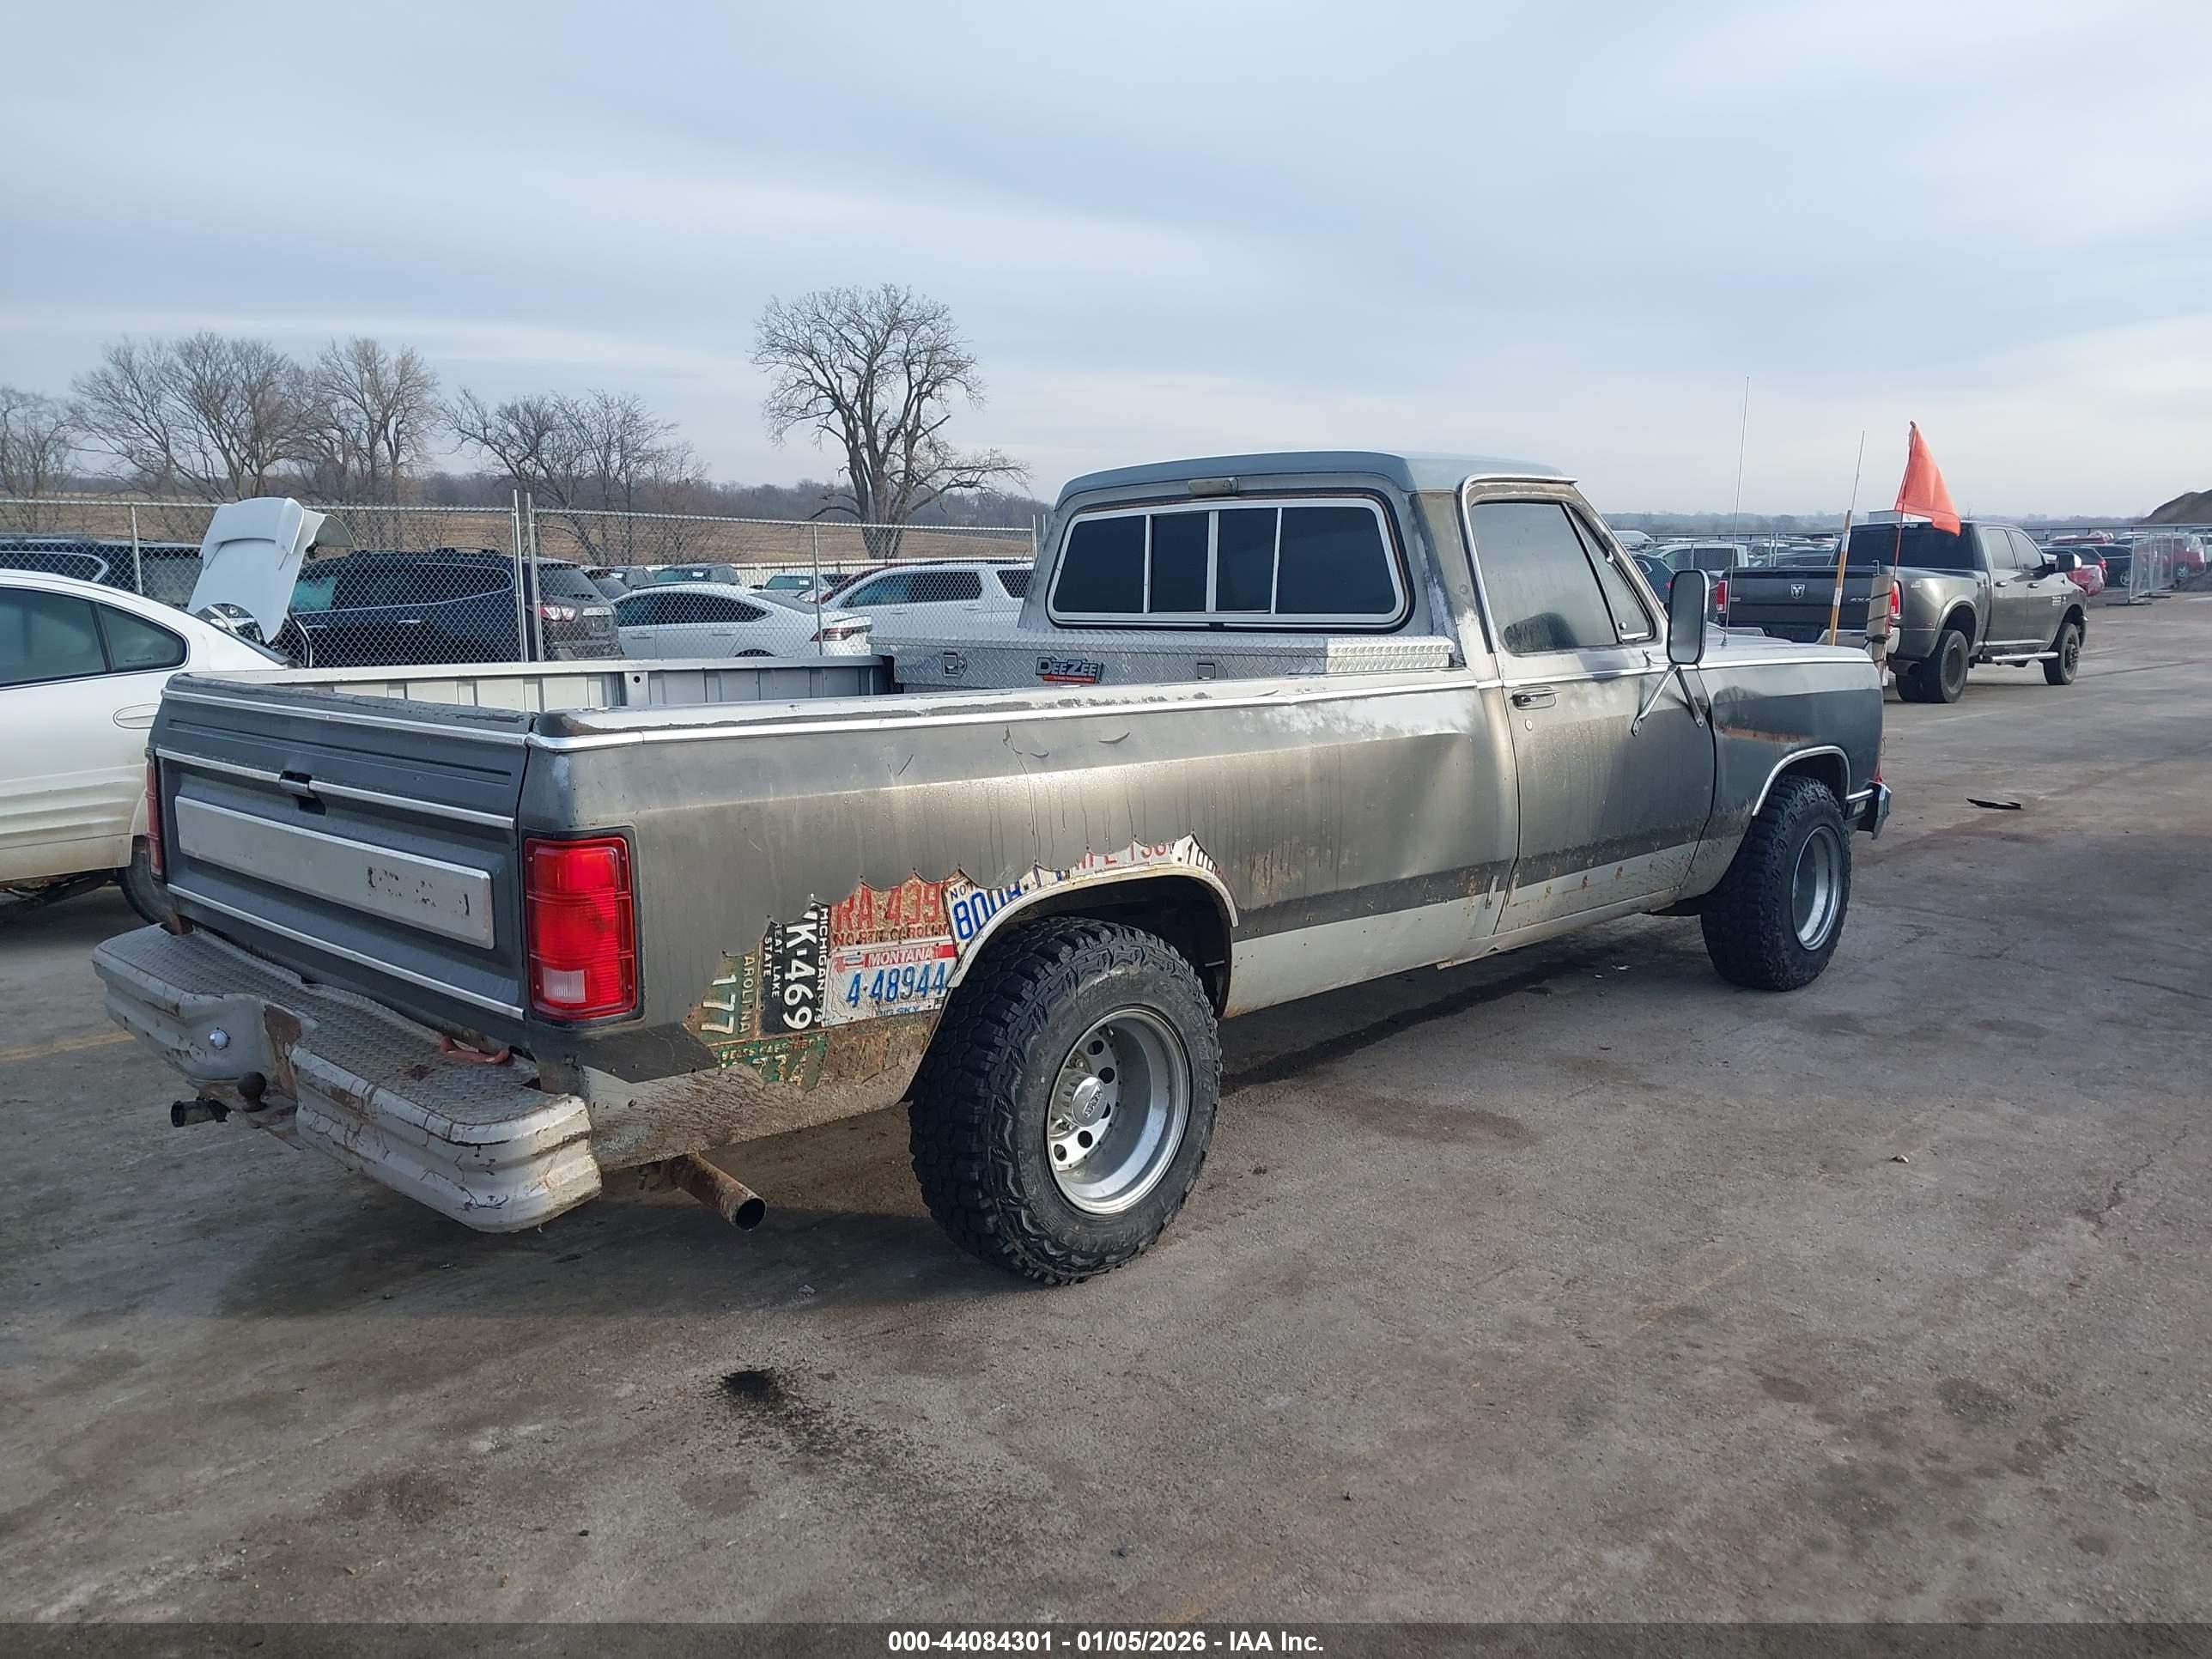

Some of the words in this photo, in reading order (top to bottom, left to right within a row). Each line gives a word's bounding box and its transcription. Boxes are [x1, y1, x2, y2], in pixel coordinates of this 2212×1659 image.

[763, 936, 773, 977] STATE
[817, 908, 830, 991] MICHIGAN
[867, 947, 934, 967] MONTANA
[772, 966, 782, 998] LAKE
